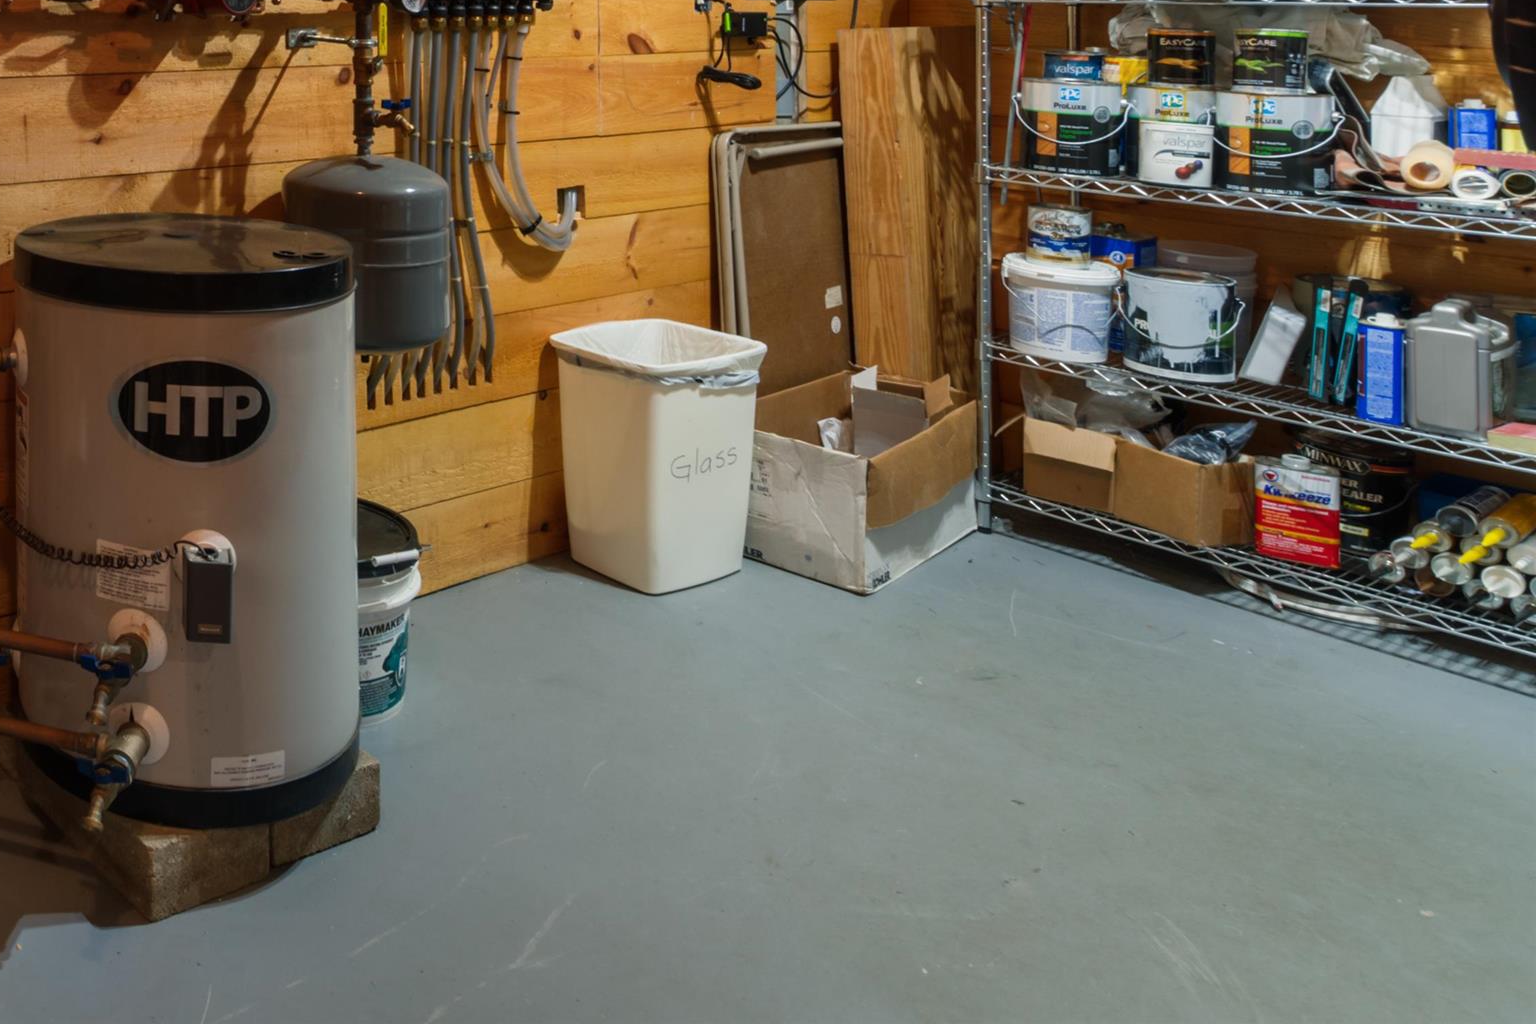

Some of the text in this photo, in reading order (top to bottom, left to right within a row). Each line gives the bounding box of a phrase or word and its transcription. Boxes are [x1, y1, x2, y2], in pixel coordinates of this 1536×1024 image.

[1054, 63, 1095, 75] valspar
[1053, 102, 1087, 111] ProLuxe
[1162, 135, 1207, 149] valspar
[133, 380, 263, 438] HTP
[670, 446, 738, 483] Glass
[1303, 445, 1364, 474] MINWAX
[1264, 484, 1332, 506] Kweeze
